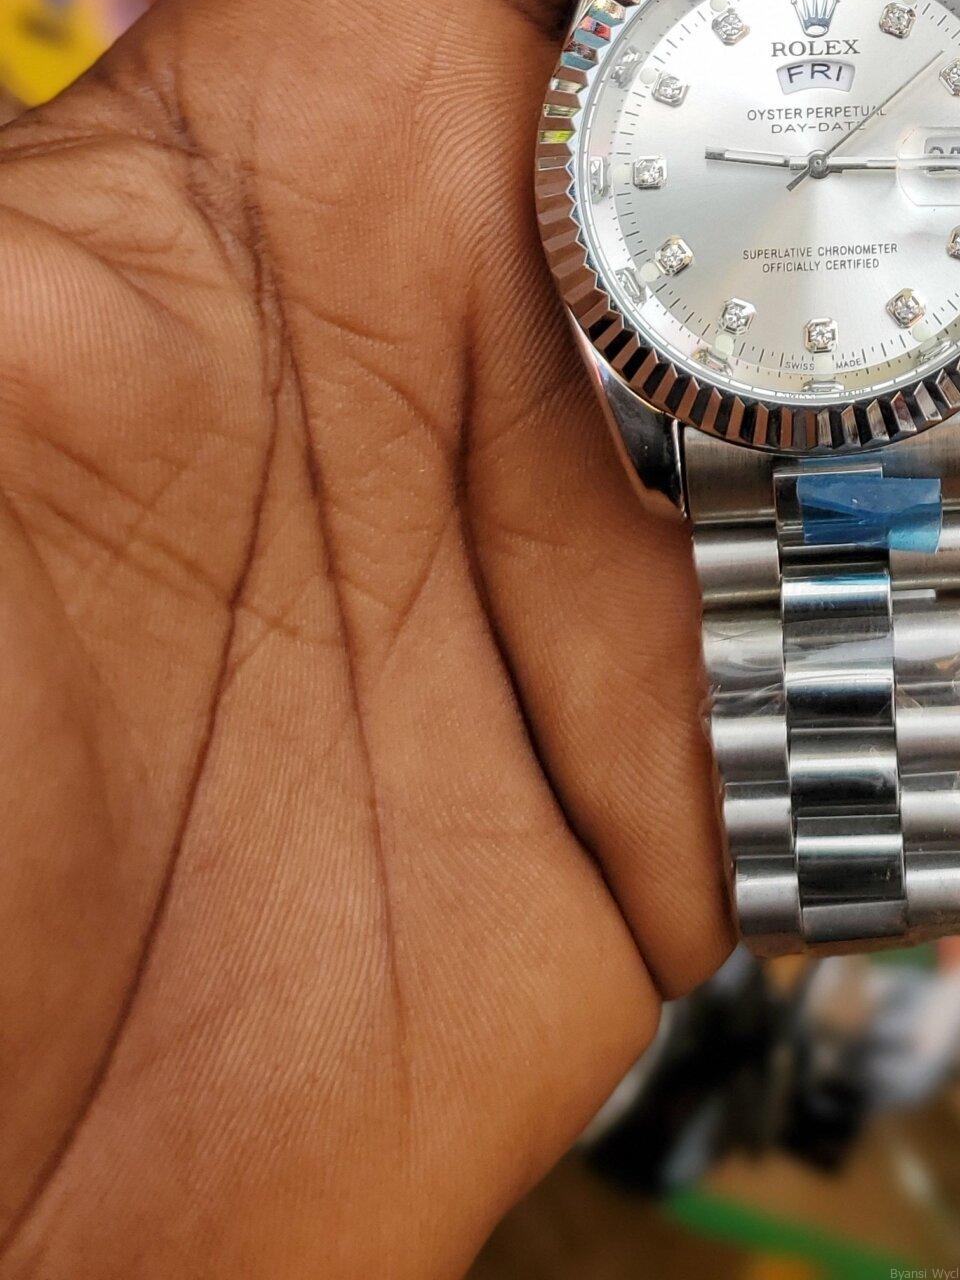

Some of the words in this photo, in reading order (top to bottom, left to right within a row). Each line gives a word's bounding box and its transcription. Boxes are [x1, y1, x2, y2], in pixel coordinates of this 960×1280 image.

[771, 39, 861, 57] ROLEX
[786, 63, 843, 84] FRI
[747, 108, 803, 121] OYSTER
[743, 247, 812, 260] SUPERLATIVE
[818, 243, 898, 257] CHRONOMETER
[762, 260, 821, 273] OFFICIALLY
[826, 258, 880, 271] CERTIFIED
[784, 361, 815, 371] SWISS
[835, 358, 862, 370] MADE
